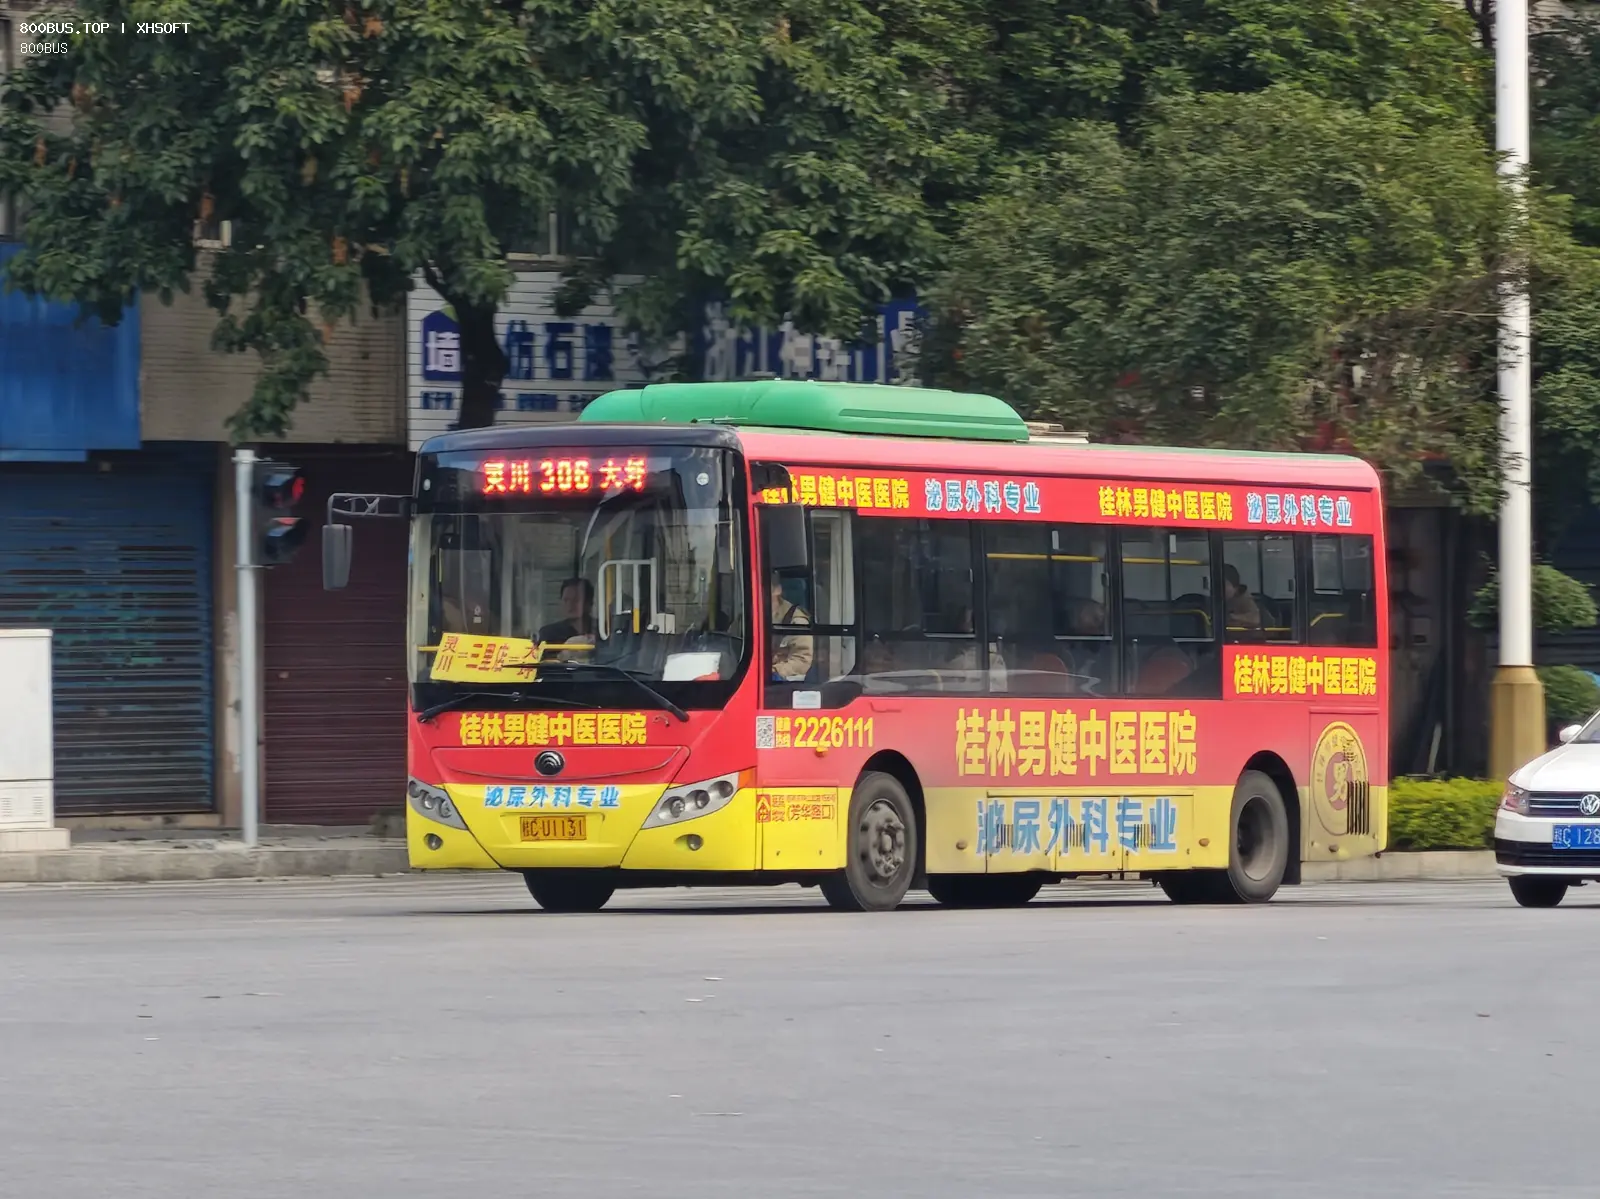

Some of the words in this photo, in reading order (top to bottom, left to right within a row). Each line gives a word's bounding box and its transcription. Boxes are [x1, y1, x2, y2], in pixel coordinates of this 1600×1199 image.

[483, 459, 531, 493] 灵川
[539, 459, 591, 492] 306
[924, 478, 1042, 514] 泌尿外科专业
[1098, 486, 1233, 522] 桂林男健中医医院
[1246, 492, 1353, 528] 泌尿外科专业
[1234, 654, 1377, 696] 桂林男健中医医院
[459, 712, 647, 746] 桂林男健中医医院
[794, 716, 874, 748] 2226111
[955, 707, 1198, 777] 桂林男健中医医院
[484, 785, 620, 808] 泌尿外科专业
[975, 797, 1178, 856] 泌尿外科专业
